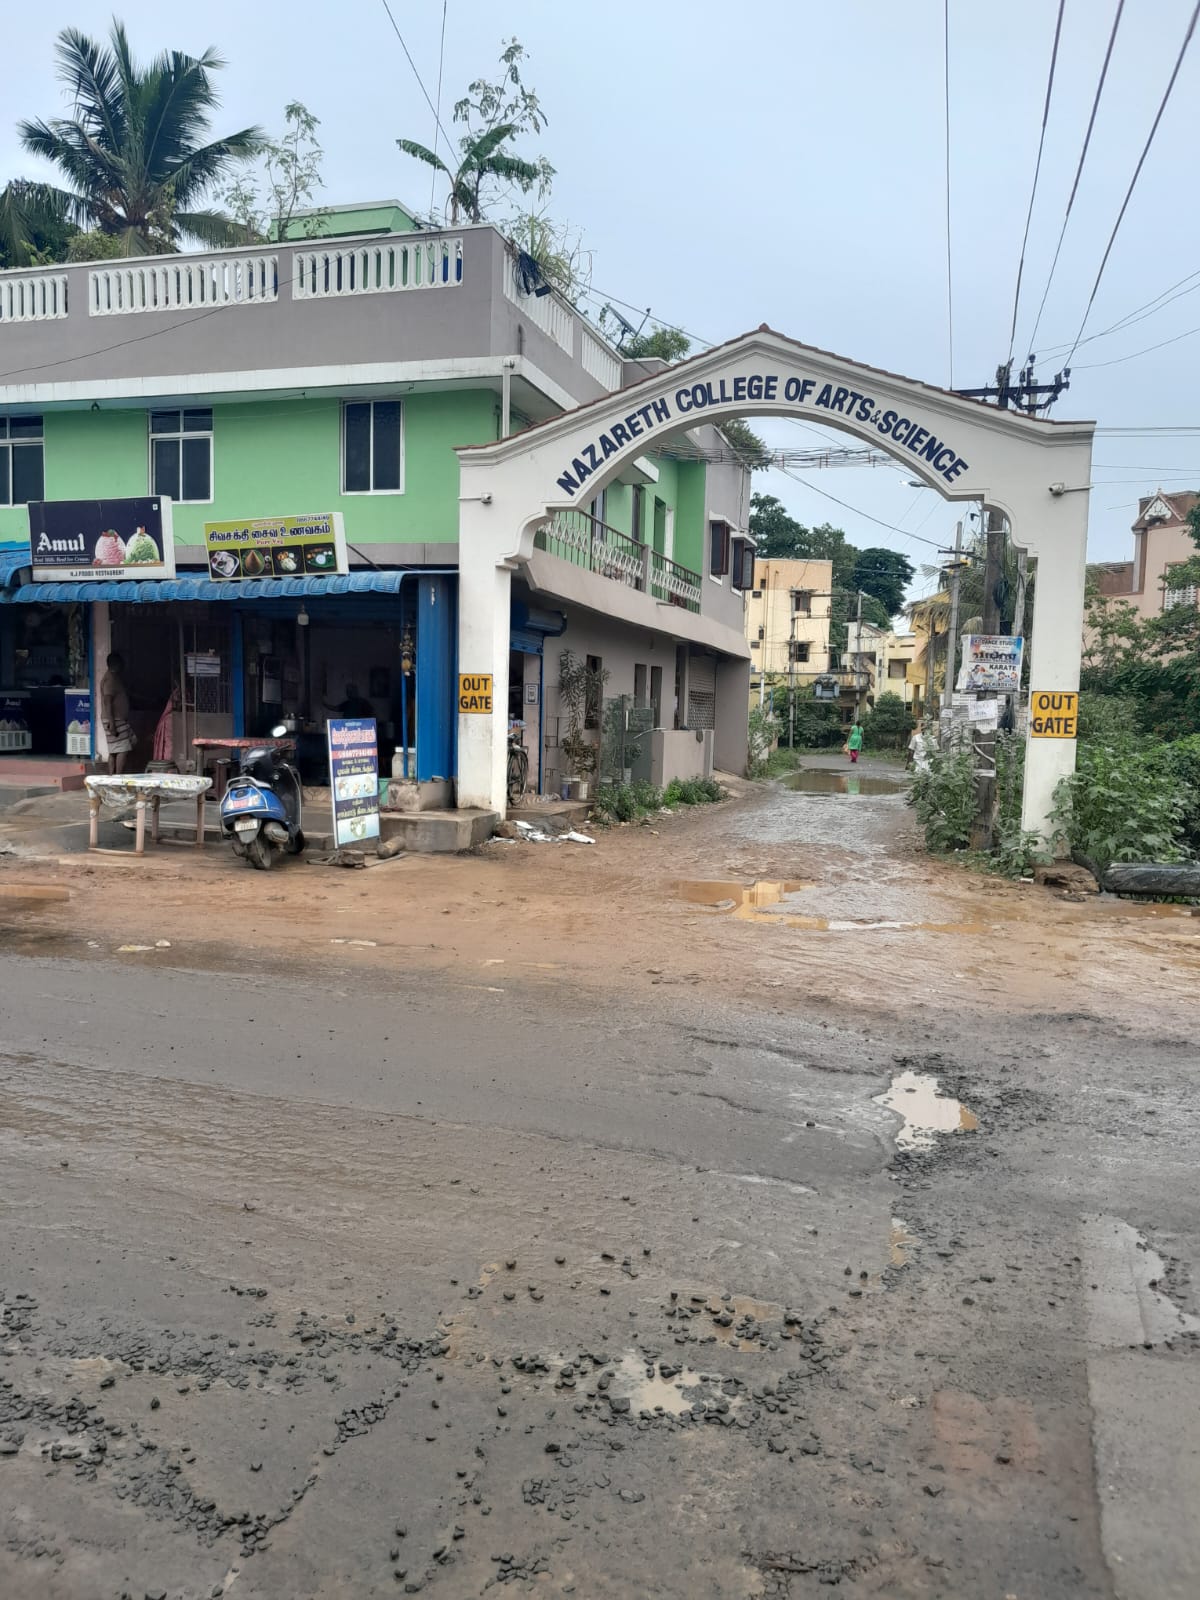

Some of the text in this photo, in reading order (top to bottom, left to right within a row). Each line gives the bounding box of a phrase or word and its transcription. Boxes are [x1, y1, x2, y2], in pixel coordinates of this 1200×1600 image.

[556, 397, 671, 497] NAZARETH
[675, 375, 778, 412] COLLEGE
[784, 377, 817, 402] OF
[877, 410, 969, 483] SCIENCE
[36, 532, 86, 554] Amul
[209, 528, 249, 544] சிவசக்தி
[252, 529, 278, 539] சைவ
[462, 678, 490, 691] OUT
[460, 695, 492, 709] GATE
[1038, 695, 1075, 710] OUT
[1032, 717, 1075, 734] GATE
